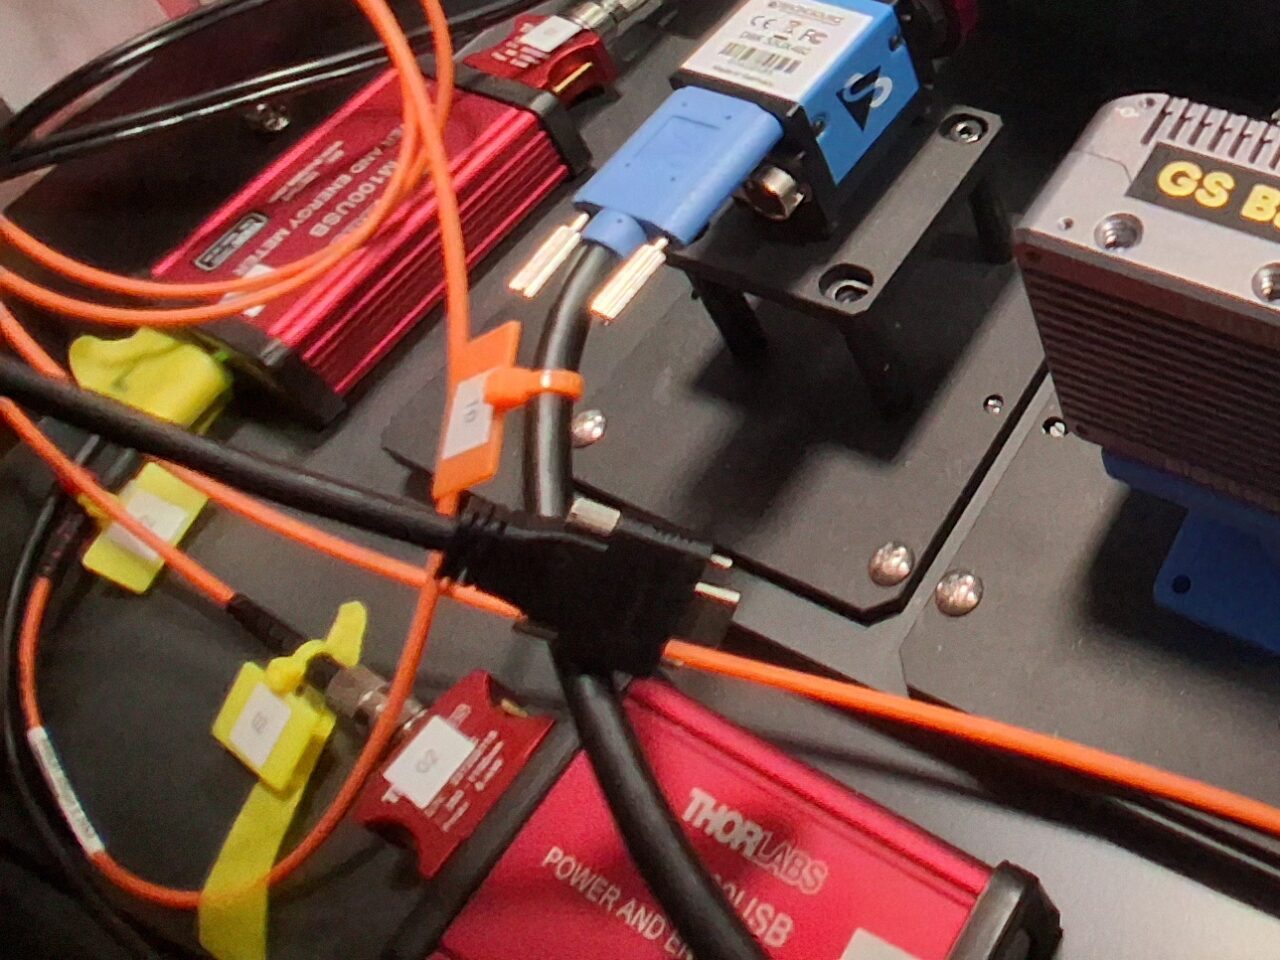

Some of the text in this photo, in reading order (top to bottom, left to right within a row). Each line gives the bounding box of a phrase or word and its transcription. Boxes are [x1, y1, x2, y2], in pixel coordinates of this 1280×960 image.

[288, 173, 353, 231] ENERGY
[1157, 160, 1236, 209] GS
[681, 787, 829, 895] THORLABS
[541, 845, 667, 941] POWER AND
